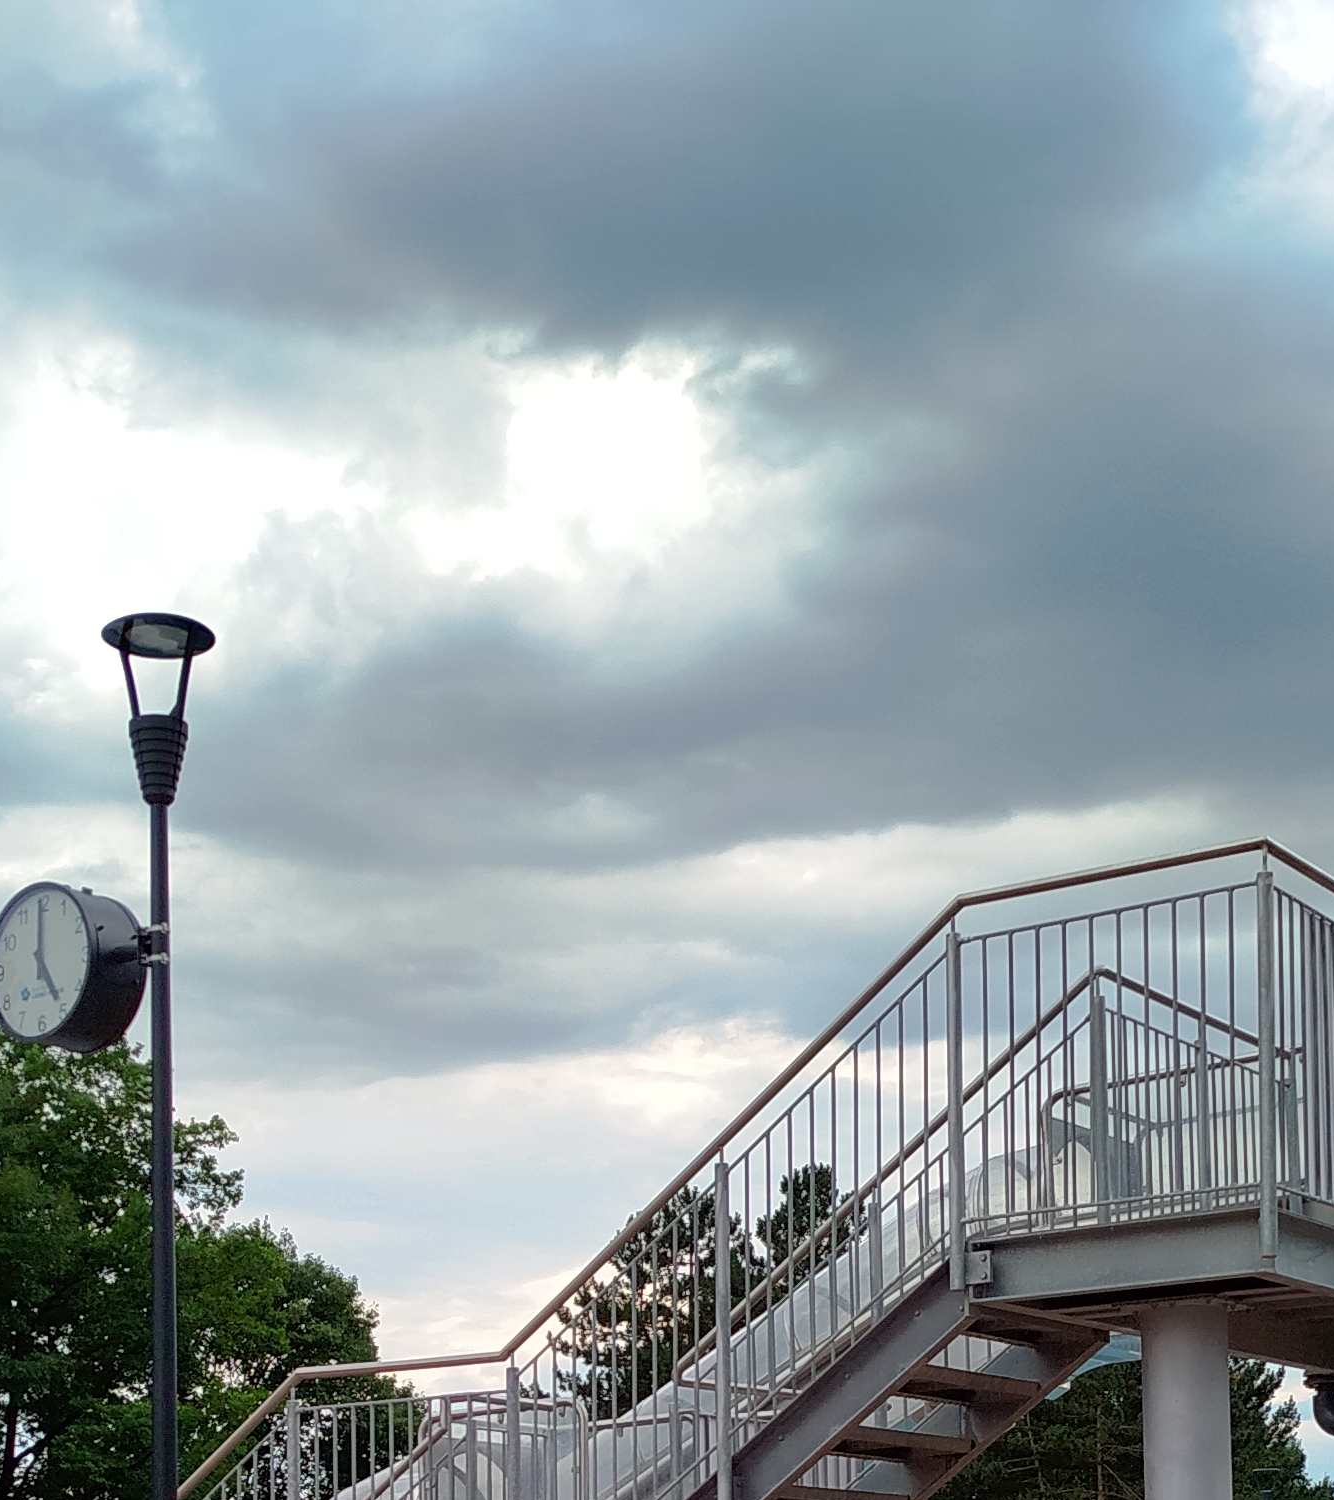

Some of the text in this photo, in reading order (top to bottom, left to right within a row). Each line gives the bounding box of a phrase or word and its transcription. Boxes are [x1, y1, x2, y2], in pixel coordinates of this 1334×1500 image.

[61, 899, 66, 916] 1
[17, 908, 28, 925] 11
[75, 917, 83, 934] 2
[2, 934, 17, 951] 10
[3, 994, 11, 1011] 8
[18, 1011, 26, 1029] 7
[58, 1003, 67, 1020] 5
[38, 1015, 46, 1032] 6
